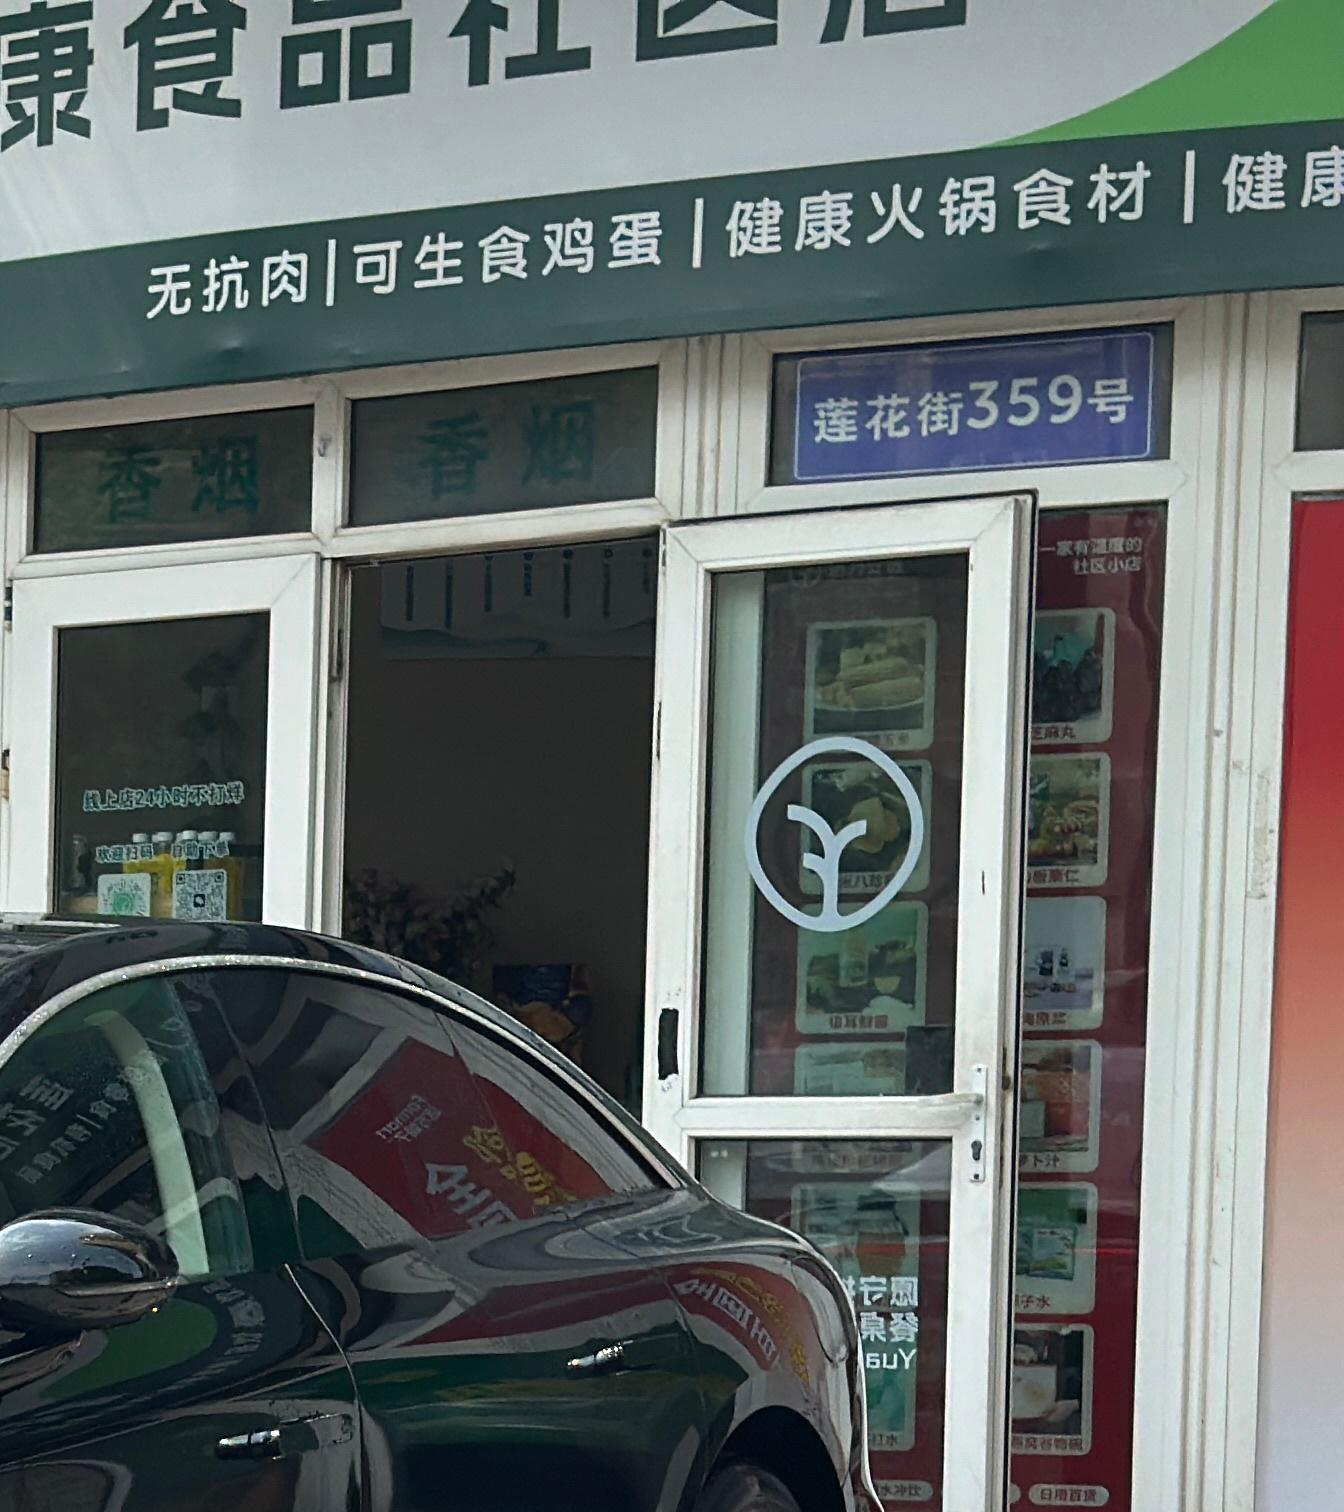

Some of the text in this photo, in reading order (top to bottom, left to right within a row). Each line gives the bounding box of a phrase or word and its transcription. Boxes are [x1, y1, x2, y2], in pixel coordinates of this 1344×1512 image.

[813, 374, 1135, 444] 莲花街359号
[1072, 556, 1143, 576] 社区小店
